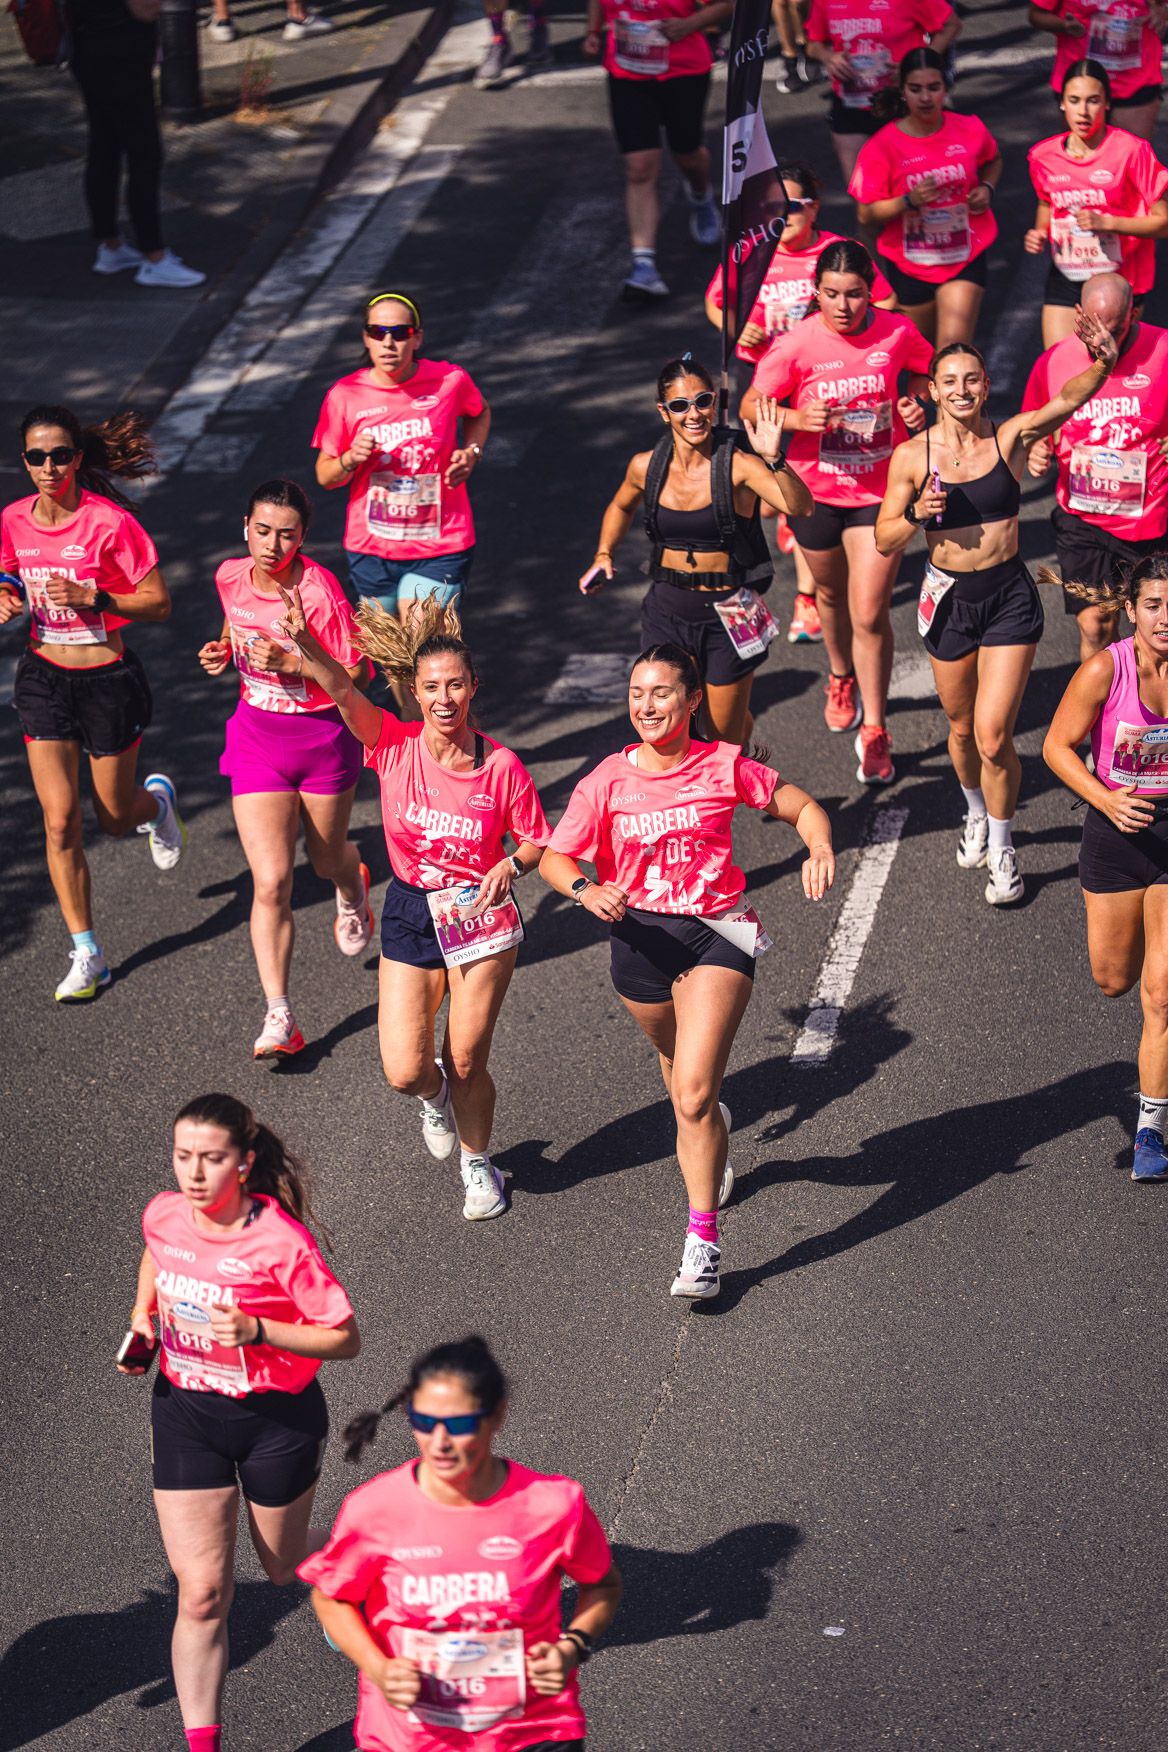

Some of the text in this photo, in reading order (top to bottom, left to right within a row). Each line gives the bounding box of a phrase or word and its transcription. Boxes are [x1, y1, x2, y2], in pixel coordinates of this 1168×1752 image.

[731, 140, 747, 173] 5
[818, 373, 886, 400] CARRERA
[1091, 479, 1120, 492] 016
[388, 504, 418, 516] 016
[48, 609, 78, 621] 016
[611, 793, 646, 807] OYSHO
[405, 801, 483, 843] CARRERA
[620, 805, 701, 838] CARRERA
[666, 837, 692, 865] DE
[464, 911, 496, 932] 016
[453, 948, 480, 962] OYSHO
[158, 1269, 233, 1308] CARRERA
[179, 1331, 213, 1352] 016
[402, 1570, 511, 1605] CARRERA
[441, 1677, 486, 1697] 016
